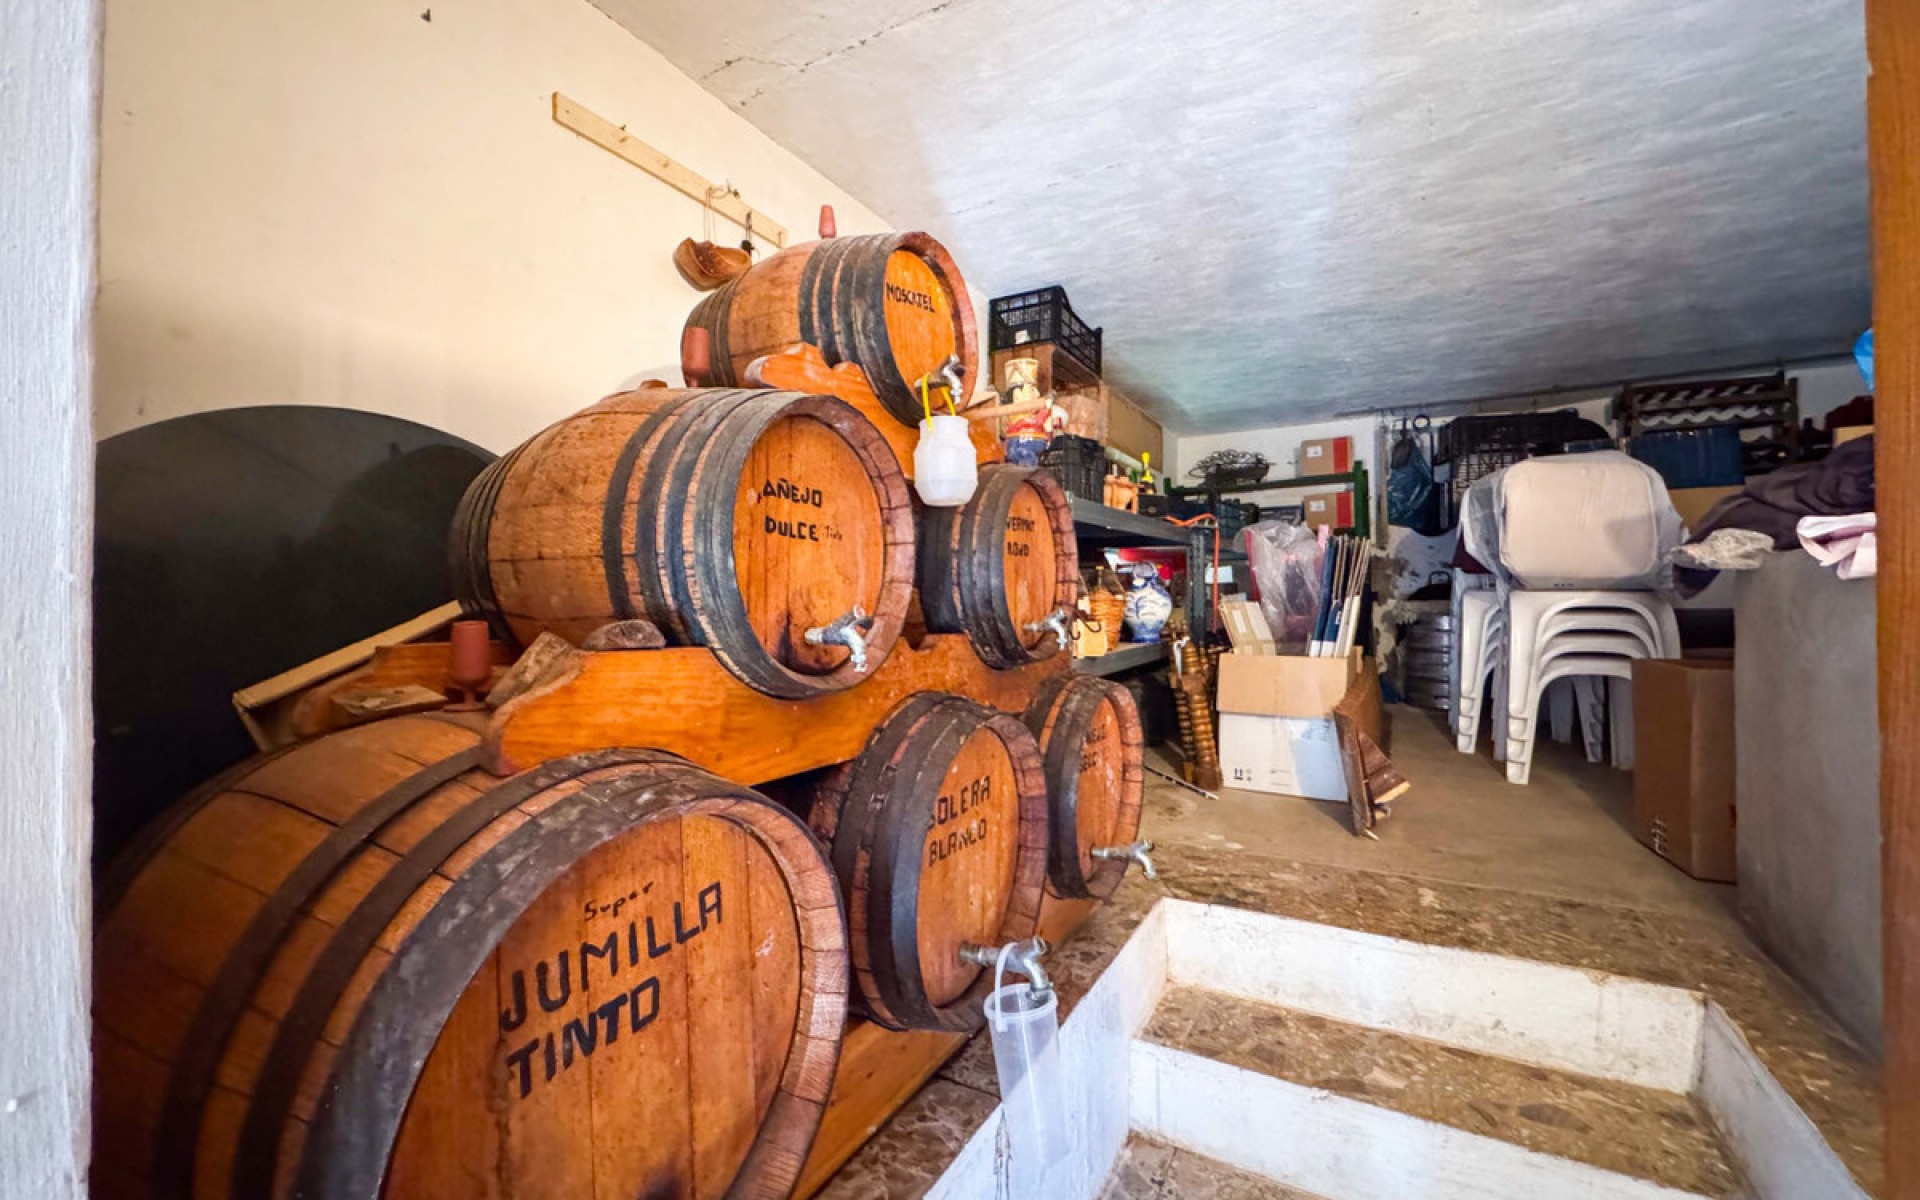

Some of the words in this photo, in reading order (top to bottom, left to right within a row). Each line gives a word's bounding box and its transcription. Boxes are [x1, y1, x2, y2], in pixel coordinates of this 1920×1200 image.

[762, 477, 822, 508] AÑEJO
[764, 515, 819, 541] DULCE
[928, 818, 987, 867] BLANCO
[583, 881, 654, 921] Super
[500, 881, 723, 1033] JUMILLA
[506, 975, 661, 1100] TINTO
